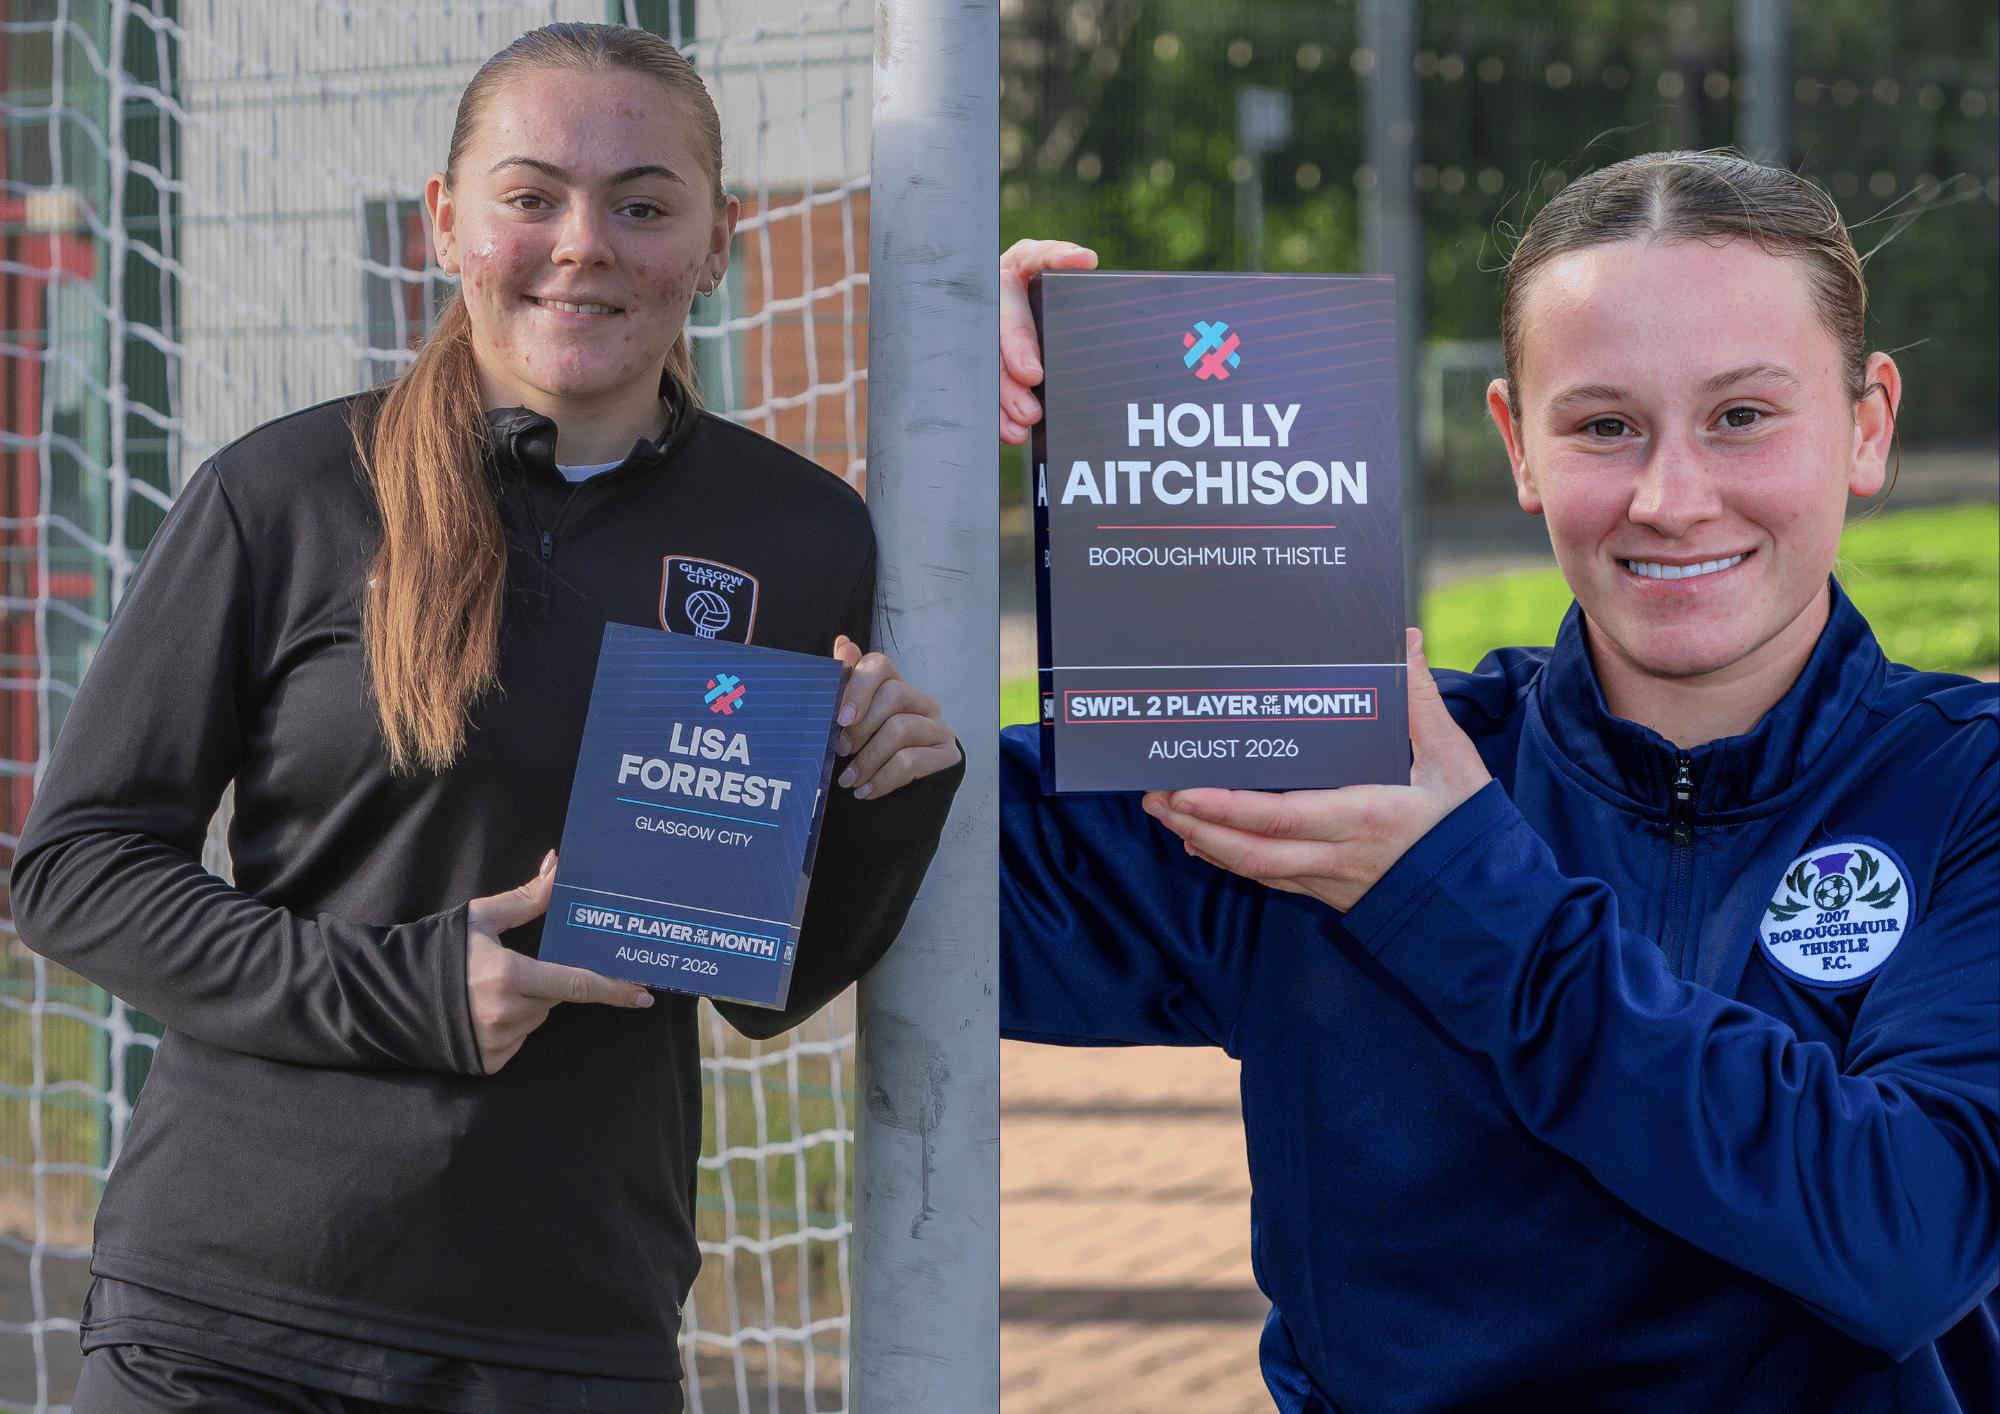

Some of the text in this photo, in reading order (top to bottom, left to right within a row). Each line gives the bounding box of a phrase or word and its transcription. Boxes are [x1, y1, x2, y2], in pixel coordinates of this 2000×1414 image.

[1127, 403, 1301, 447] HOLLY
[1061, 460, 1367, 505] AITCHISON
[1089, 546, 1346, 566] BOROUGHMUIR THISTLE
[679, 563, 743, 586] GLASGOW
[687, 573, 735, 593] CITY FC
[1071, 696, 1141, 717] SWPL
[1146, 696, 1162, 716] 2
[1167, 694, 1258, 716] PLAYER
[1259, 704, 1282, 715] THE
[1263, 696, 1278, 705] OF
[1284, 693, 1371, 715] MONTH
[669, 723, 750, 765] LISA
[1148, 738, 1299, 759] AUGUST 2026
[617, 754, 791, 810] FORREST
[635, 816, 753, 847] GLASGOW CITY
[575, 907, 623, 931] SWPL
[1816, 910, 1850, 925] 2007
[627, 917, 693, 943] PLAYER
[693, 934, 709, 945] THE
[696, 928, 708, 937] OF
[1769, 918, 1899, 945] BOROUGHMUIR
[710, 931, 775, 956] MONTH
[1800, 938, 1869, 956] THISTLE
[615, 946, 719, 976] AUGUST 2026
[1822, 956, 1851, 970] F.C.
